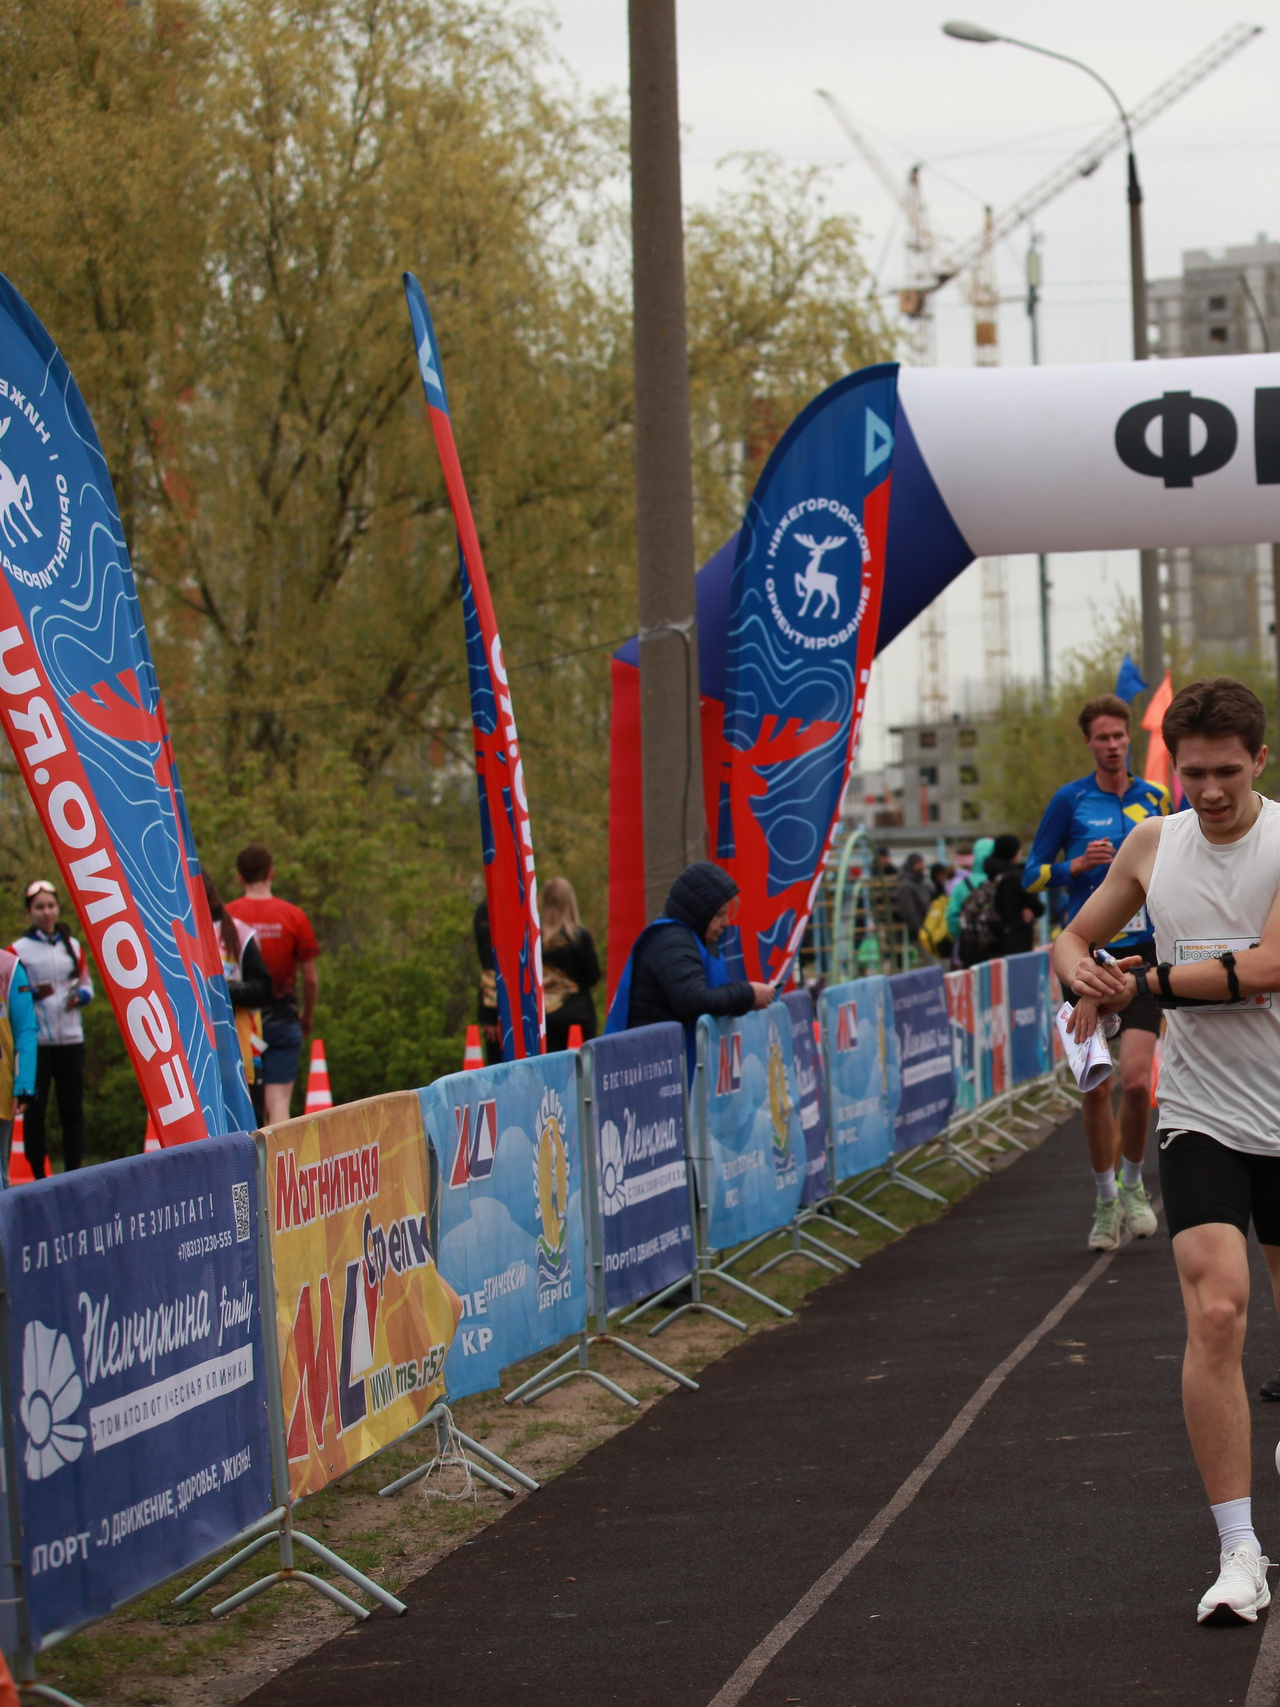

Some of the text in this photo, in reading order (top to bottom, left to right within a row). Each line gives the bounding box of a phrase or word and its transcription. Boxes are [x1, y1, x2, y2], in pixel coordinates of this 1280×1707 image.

[767, 497, 872, 564] НИЖЕГОРОДСКОЕ
[765, 577, 871, 650] ОРИЕНТИРОВАНИЕ
[1183, 949, 1239, 961] РОСС
[275, 1140, 381, 1236] Магнитная
[363, 1208, 434, 1300] Стрелк
[78, 1279, 254, 1389] Жемчужина family
[205, 1358, 248, 1391] КЛИНИКА
[111, 1489, 178, 1547] ДВИЖЕНИЕ,
